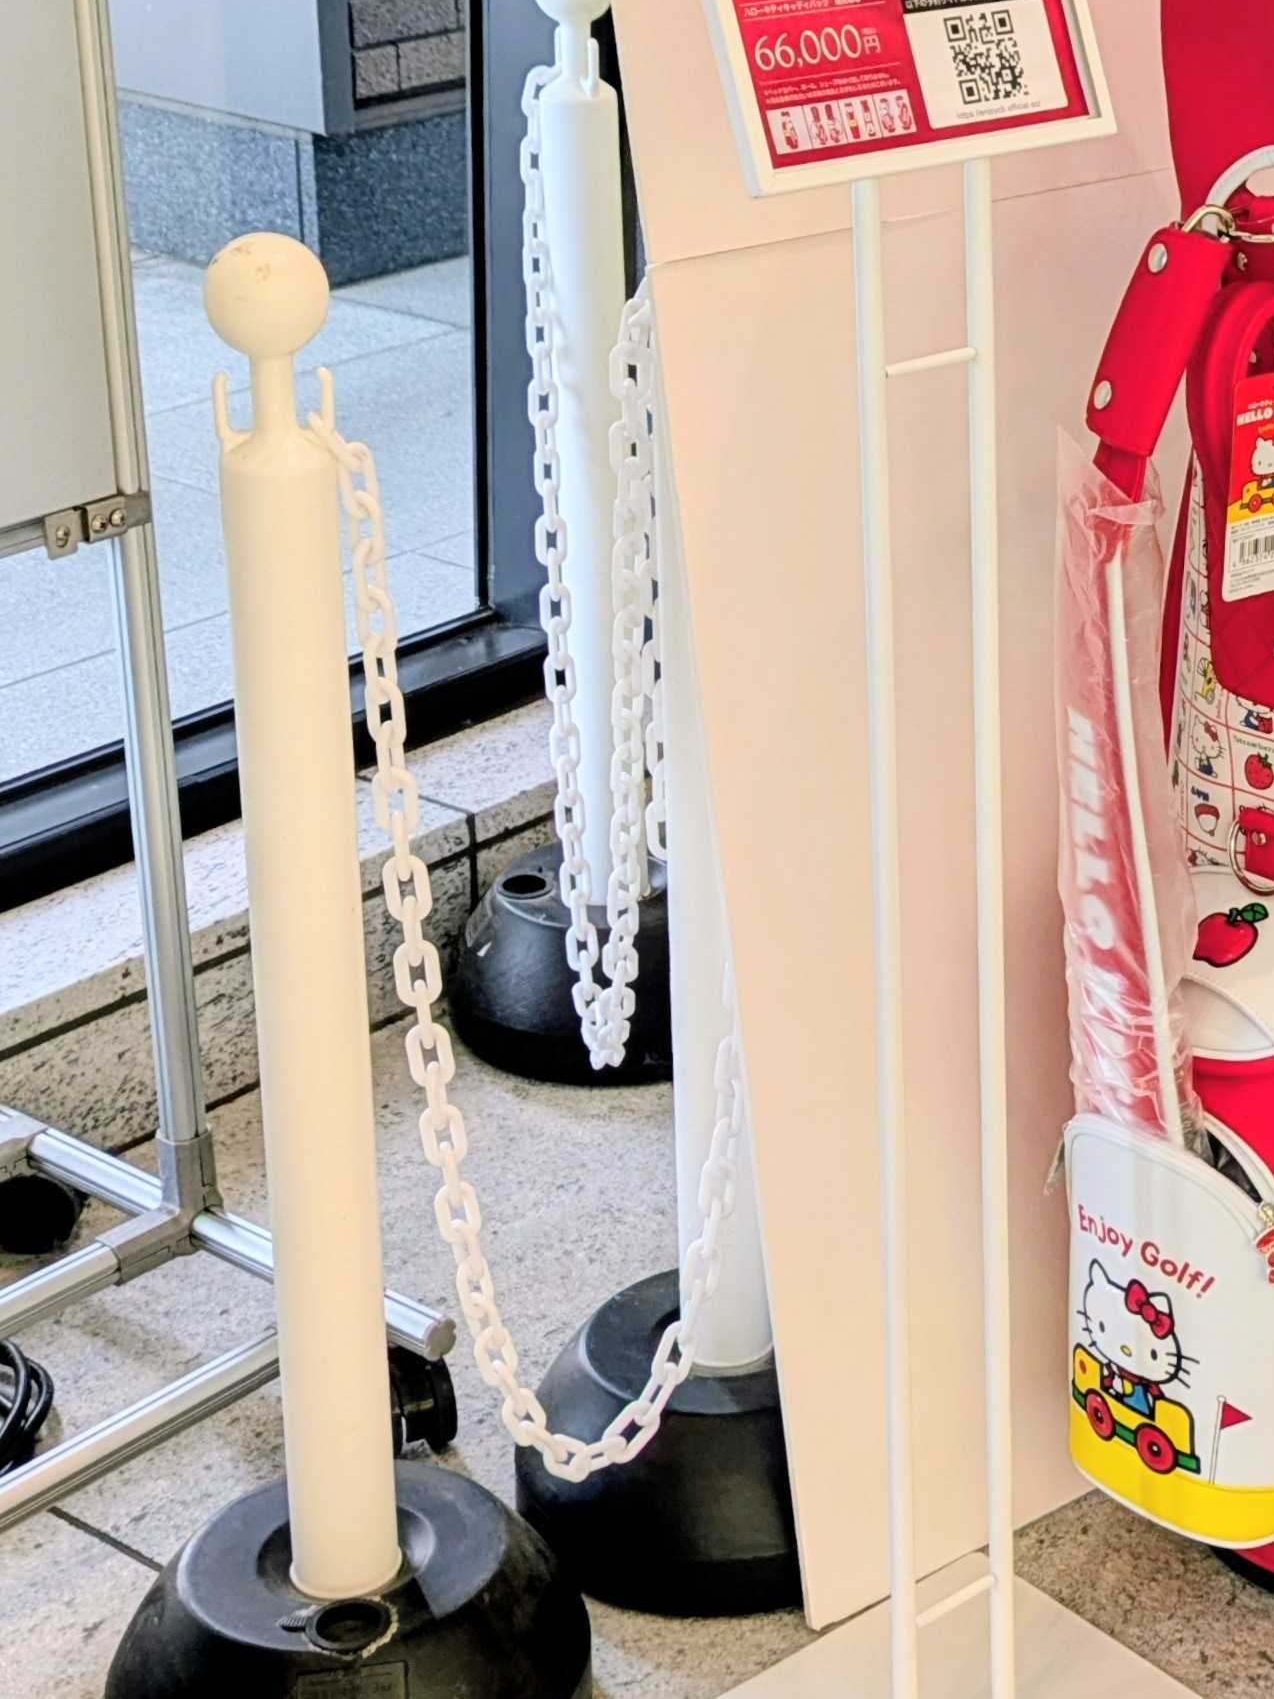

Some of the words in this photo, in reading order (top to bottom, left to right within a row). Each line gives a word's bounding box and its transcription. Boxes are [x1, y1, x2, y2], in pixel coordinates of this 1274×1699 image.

[1237, 407, 1273, 427] HELLO
[1077, 1203, 1133, 1258] Enjoy
[1140, 1240, 1217, 1299] Golf!
